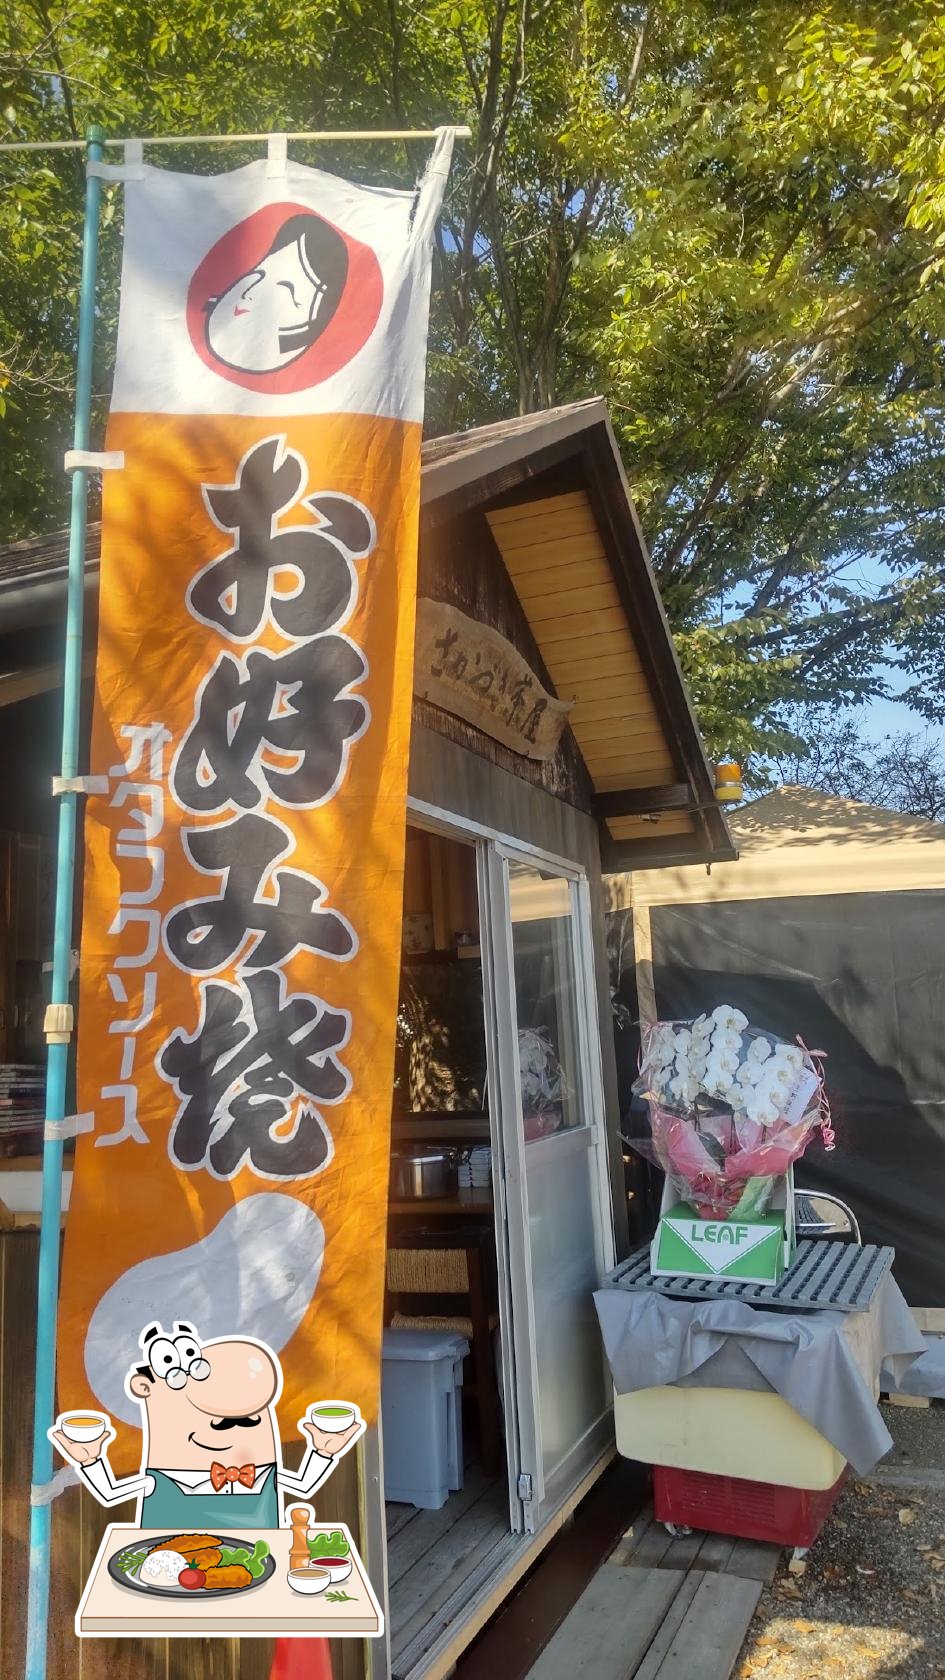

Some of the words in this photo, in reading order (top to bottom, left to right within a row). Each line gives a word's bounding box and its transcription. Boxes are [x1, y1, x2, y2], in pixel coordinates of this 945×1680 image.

[94, 722, 173, 1147] オタフクソース
[156, 434, 376, 1182] お好み焼
[691, 1224, 748, 1246] LEAF
